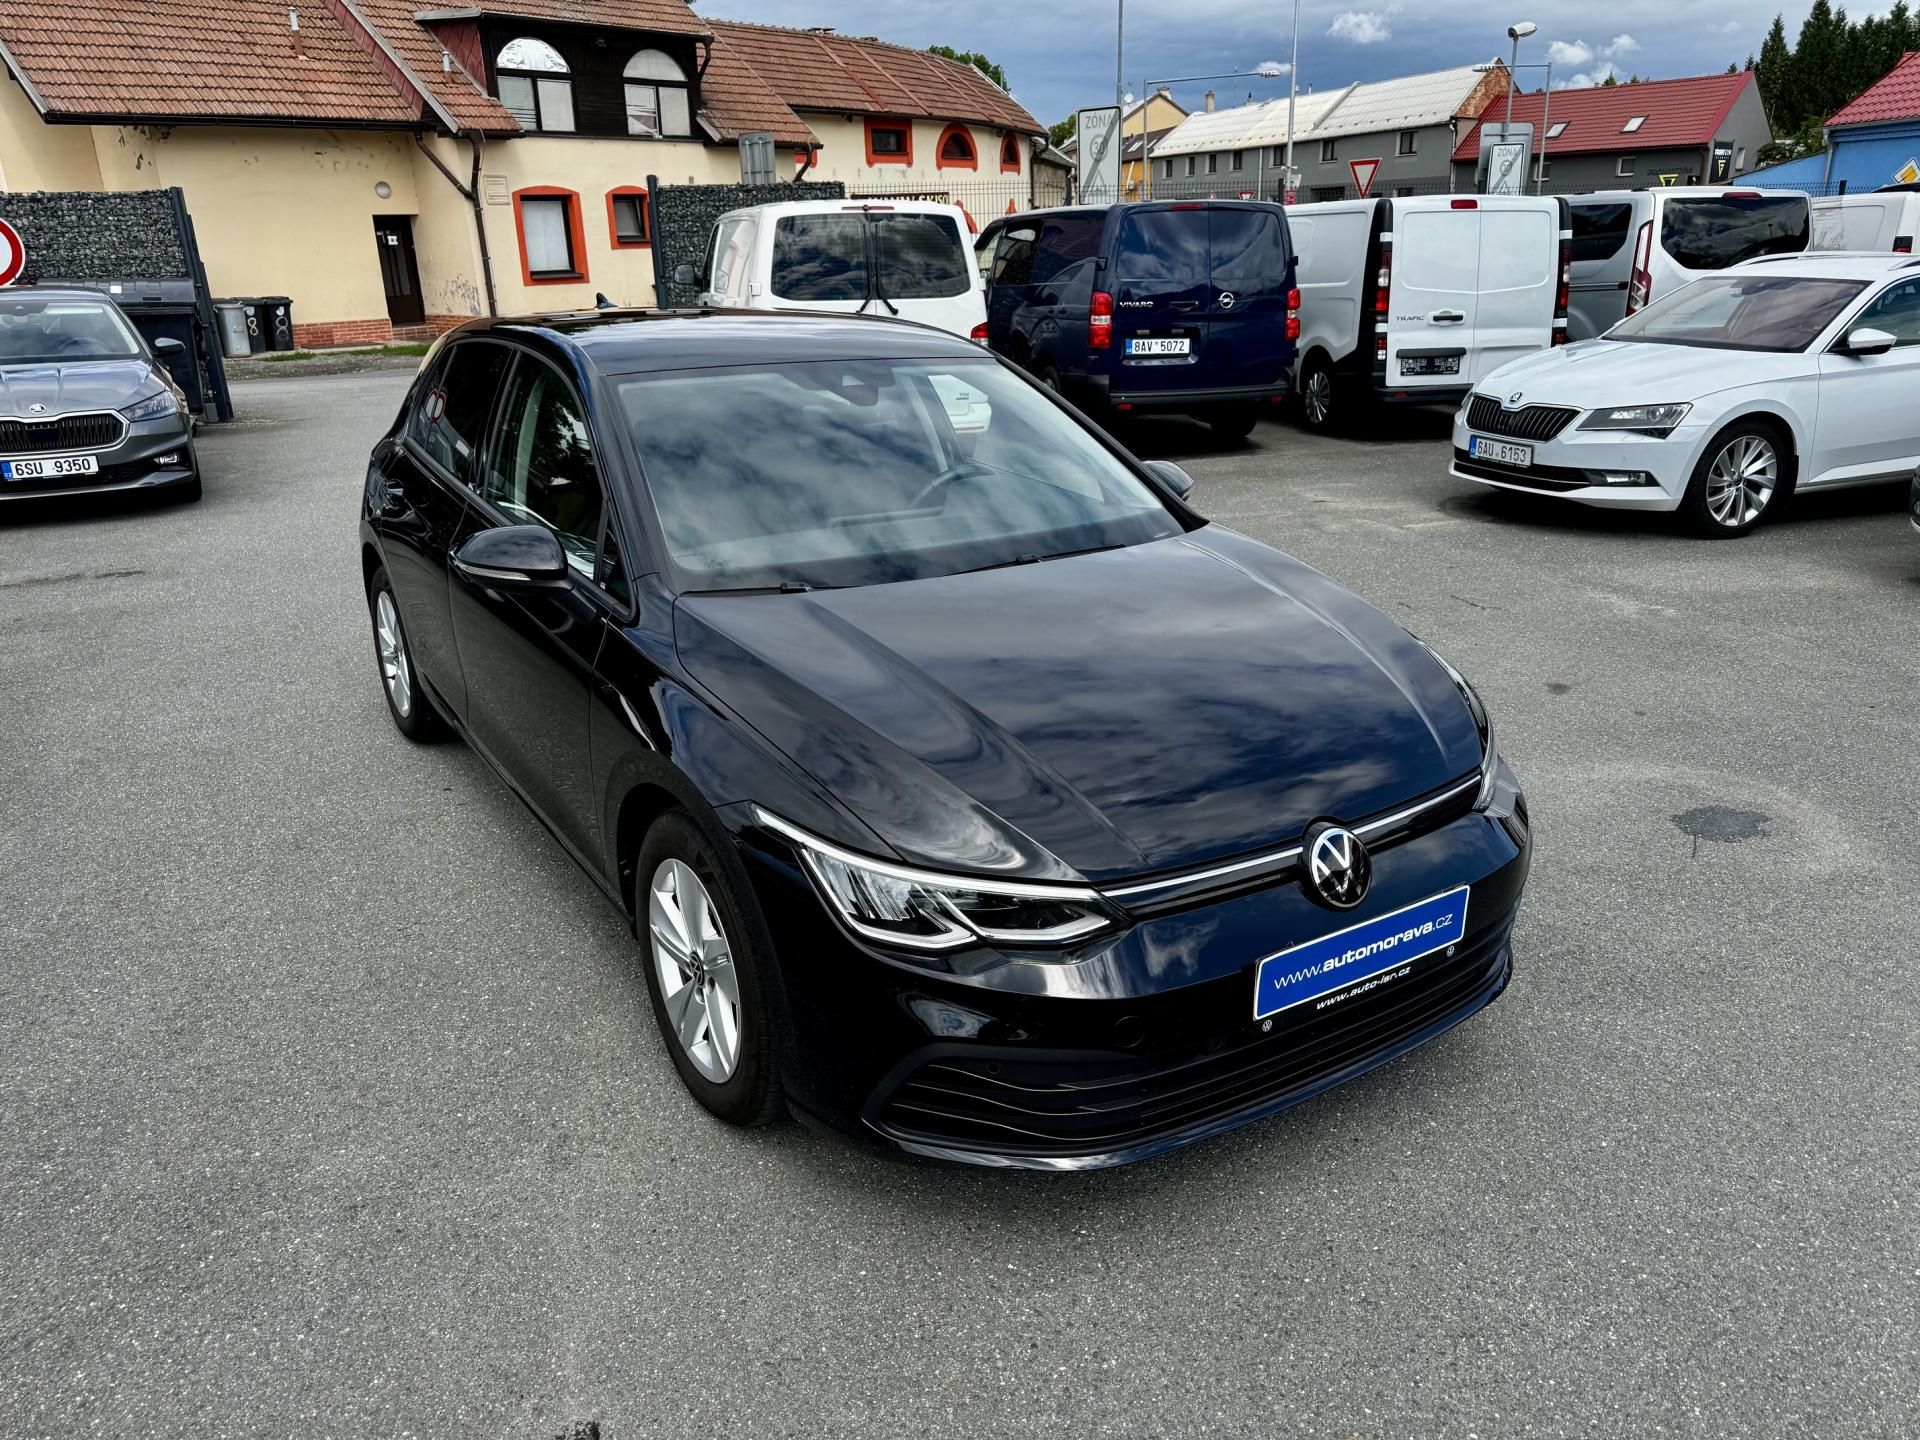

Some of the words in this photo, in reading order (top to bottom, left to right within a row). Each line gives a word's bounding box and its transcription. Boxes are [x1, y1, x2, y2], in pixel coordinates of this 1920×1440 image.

[1134, 340, 1153, 353] 8AV
[1160, 340, 1185, 352] 5072
[1477, 440, 1494, 457] 6AU
[1501, 445, 1527, 463] 6153
[14, 461, 44, 476] 6SU
[54, 458, 91, 473] 9350
[1274, 913, 1454, 990] www.automorava.cz
[1316, 965, 1412, 1011] www.auto-isr.cz
